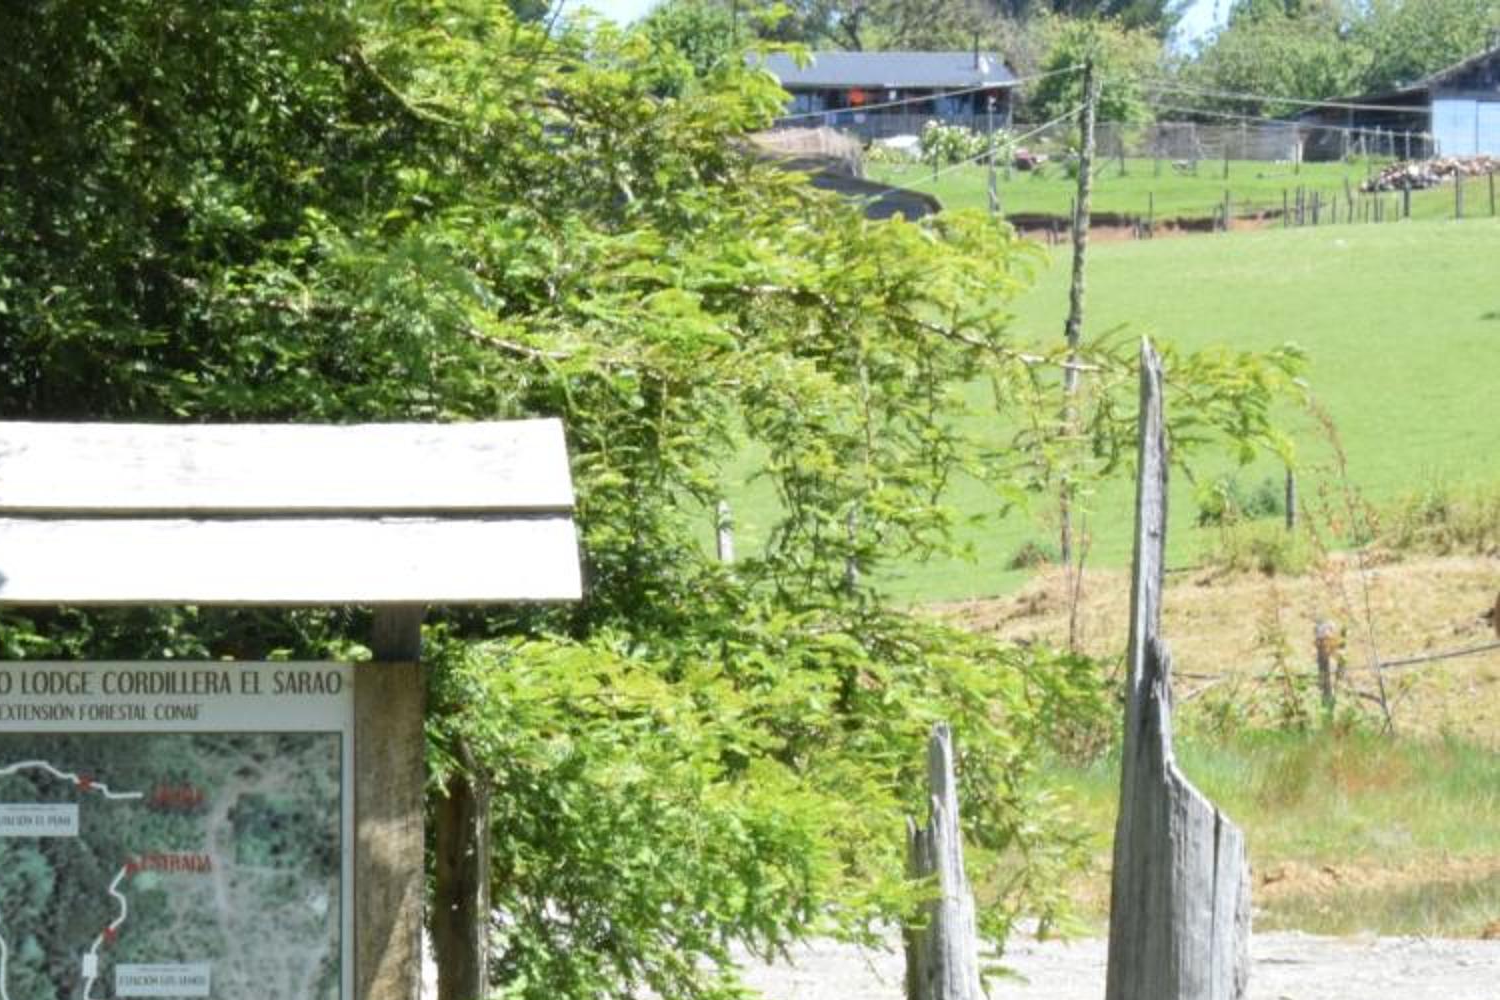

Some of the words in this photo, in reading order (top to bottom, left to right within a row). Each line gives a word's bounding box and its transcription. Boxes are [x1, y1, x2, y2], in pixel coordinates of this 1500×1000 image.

[21, 671, 95, 696] LODGE
[101, 671, 232, 696] CORDILLERA
[240, 671, 262, 696] EL
[273, 671, 342, 696] SARAO
[79, 703, 148, 721] FORESTAL
[154, 703, 202, 721] CONAF
